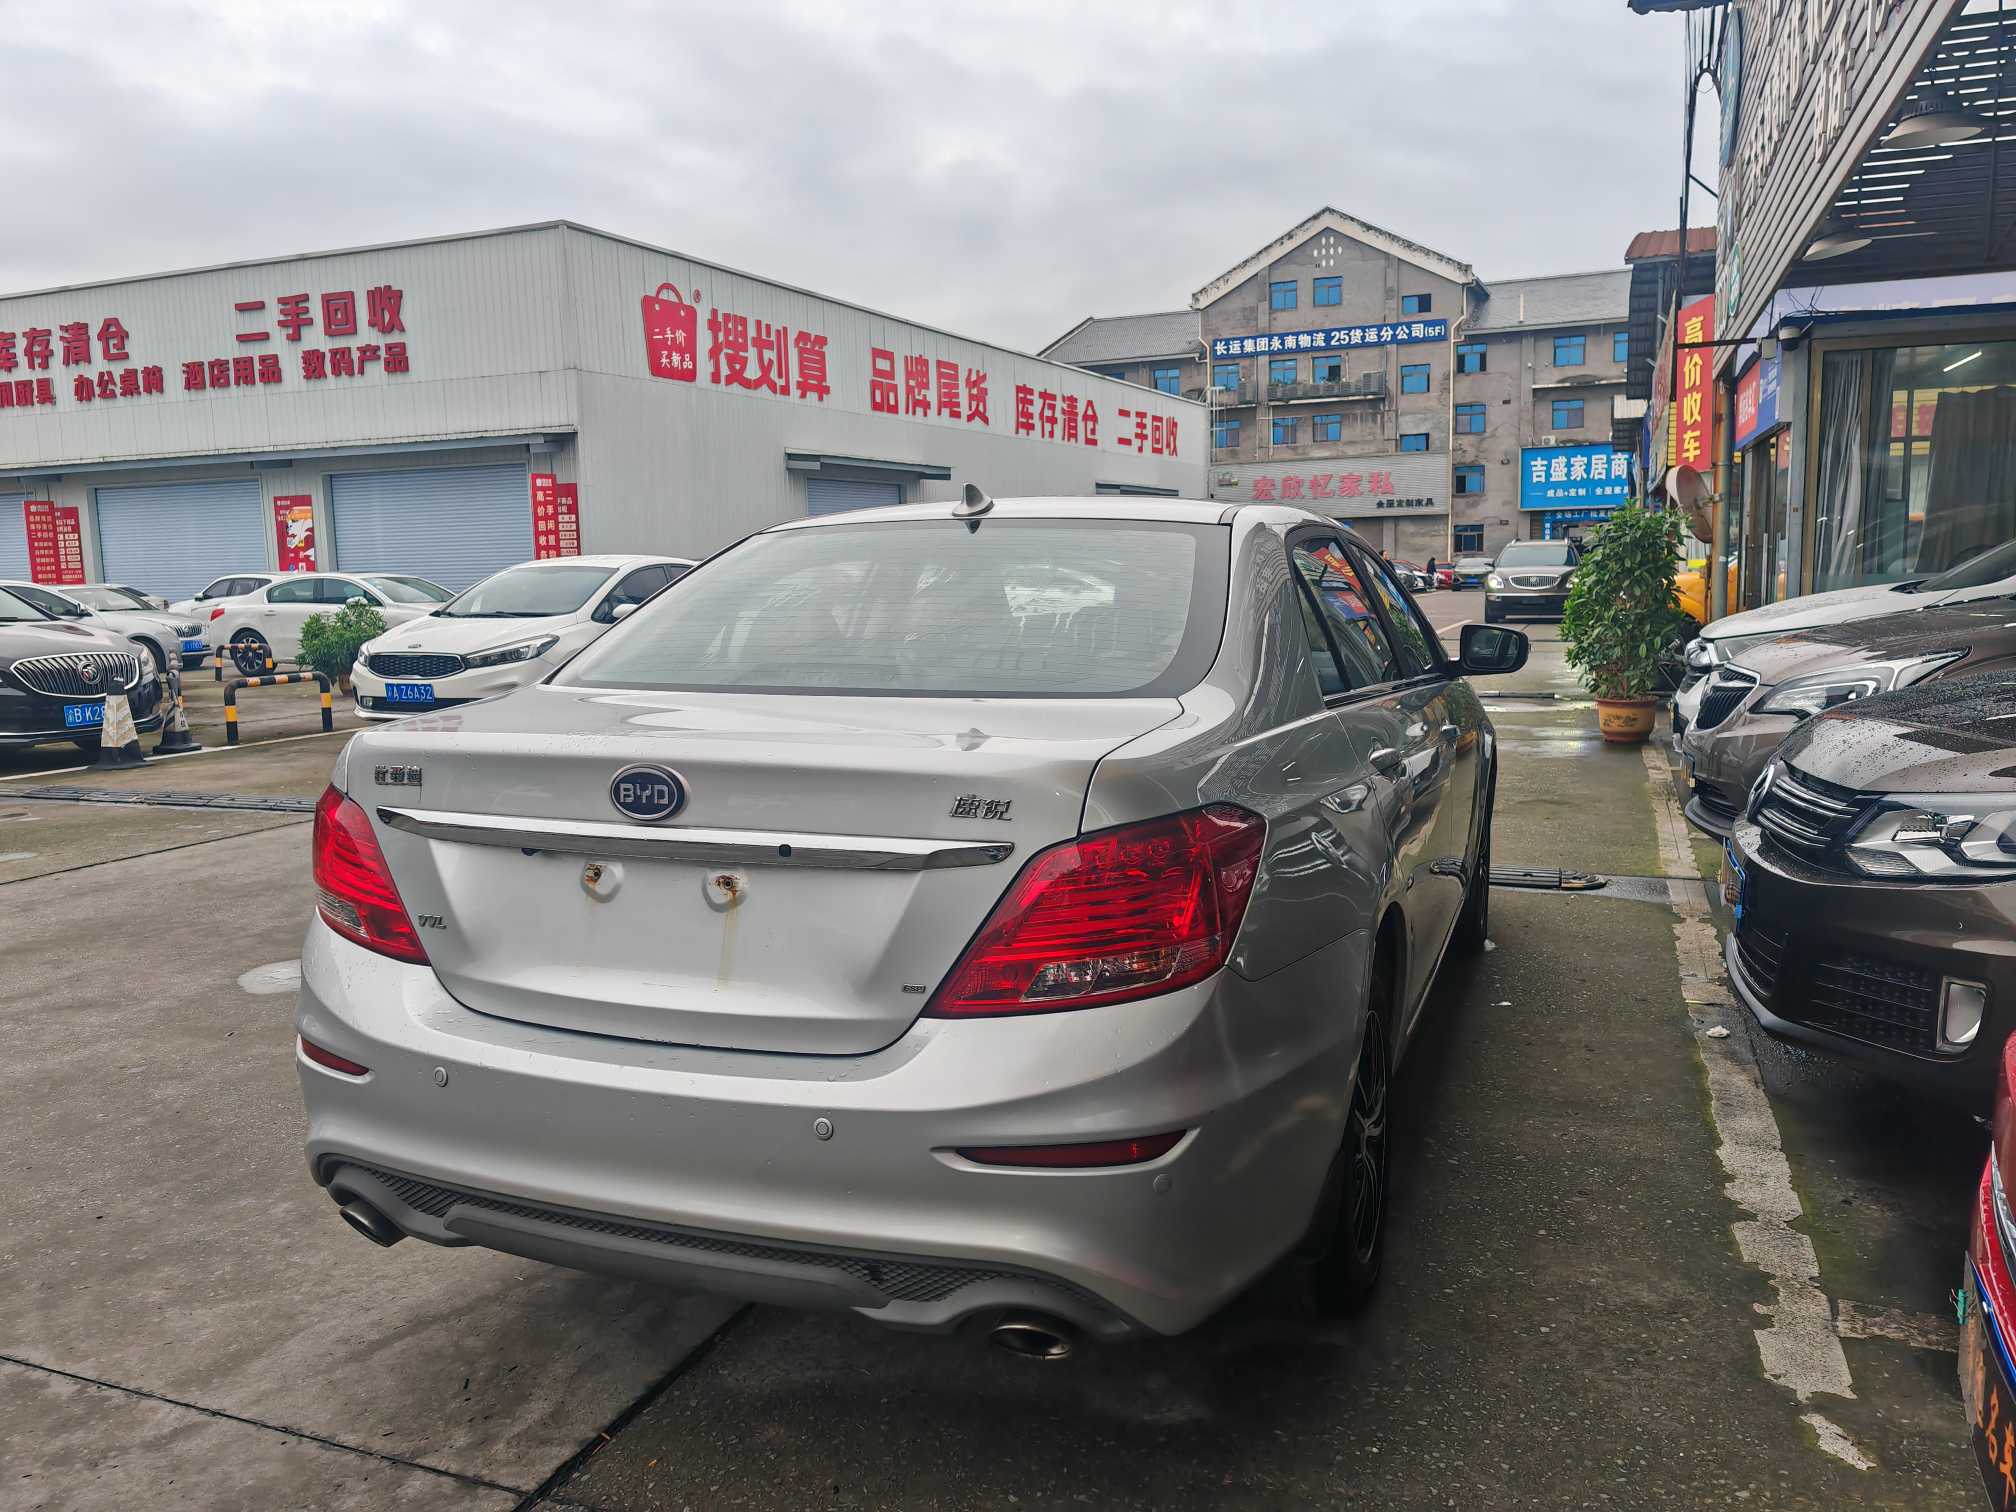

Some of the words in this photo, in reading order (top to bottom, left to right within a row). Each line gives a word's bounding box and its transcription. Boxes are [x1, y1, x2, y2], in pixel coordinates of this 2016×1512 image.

[234, 285, 406, 342] 二手回收
[653, 326, 687, 348] 二手价
[1214, 332, 1325, 355] 长运集团永南物流
[660, 350, 693, 370] 买新品
[707, 307, 830, 402] 搜划算
[74, 365, 164, 403] 办公桌椅
[182, 354, 282, 392] 酒店用品
[301, 342, 409, 380] 数码产品
[870, 347, 989, 427] 品牌尾货
[1014, 383, 1099, 446] 库存清仓
[1118, 408, 1178, 457] 二手回收
[1682, 315, 1704, 463] 高价收车
[1530, 452, 1629, 483] 吉盛家居商
[618, 783, 670, 805] BYD
[949, 794, 1013, 821] 速锐
[417, 914, 448, 930] VVL
